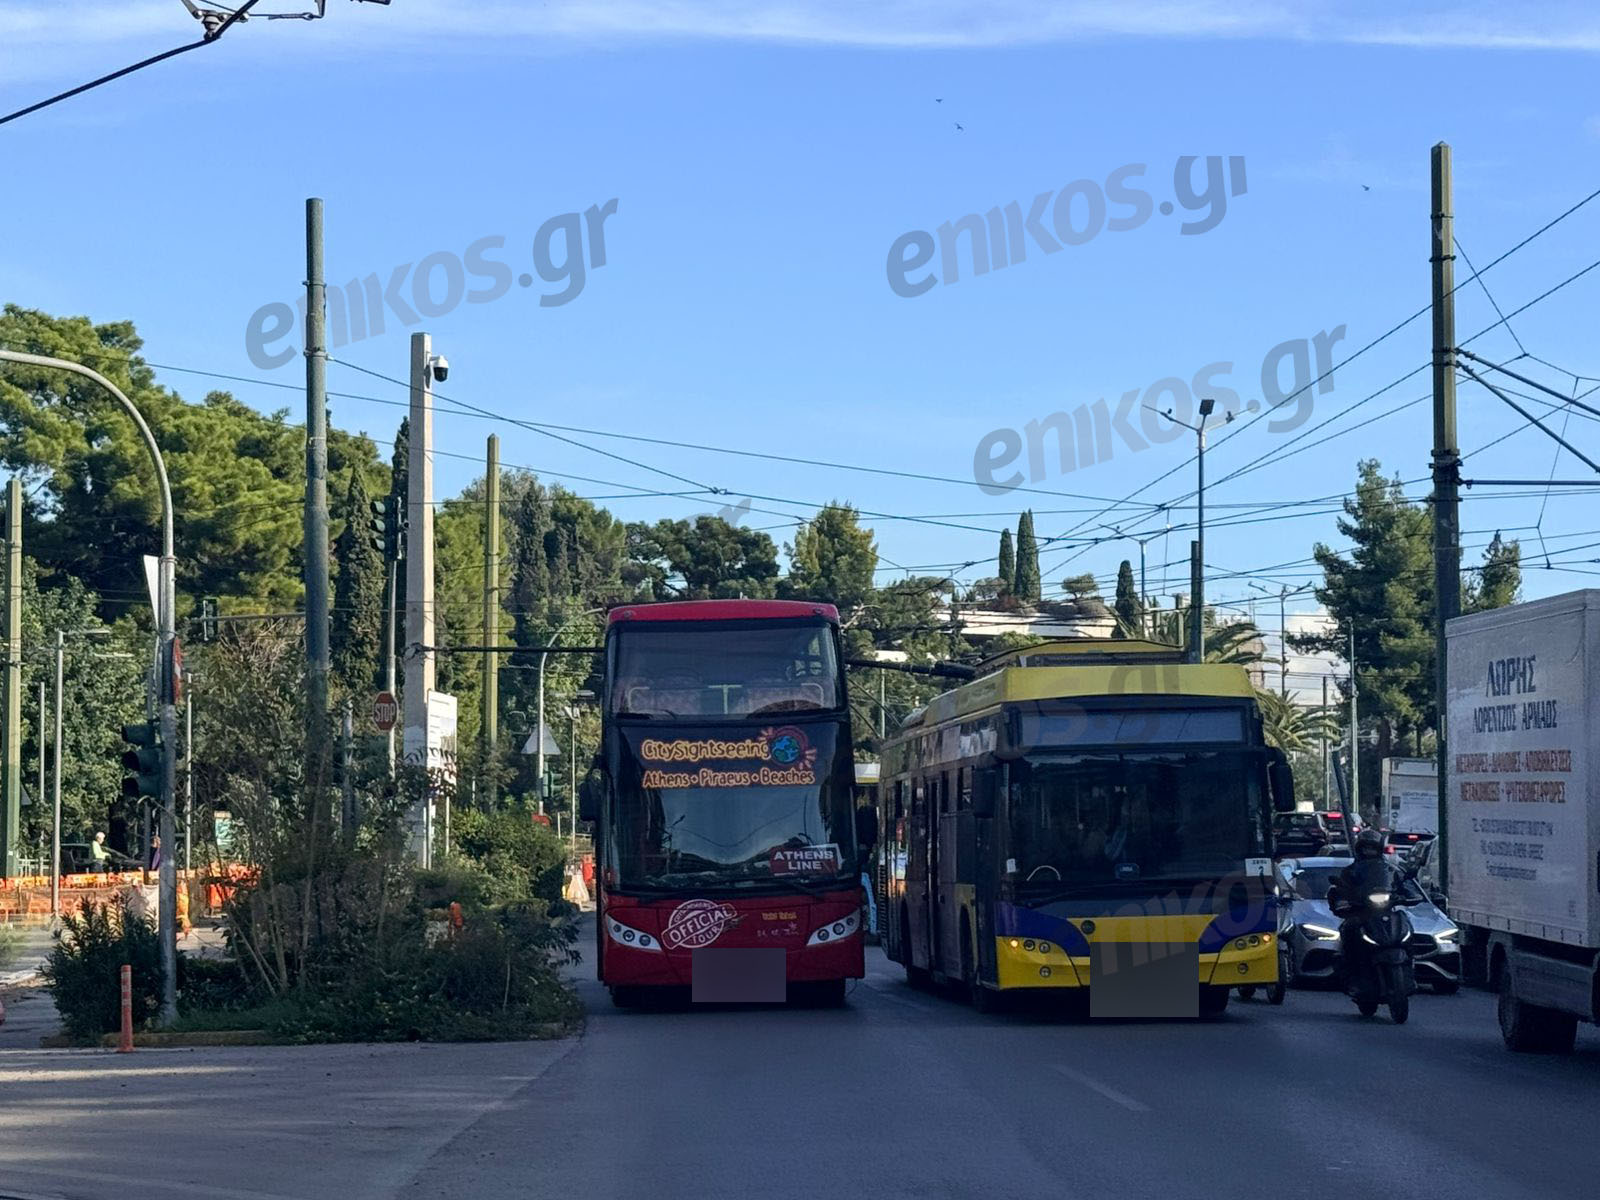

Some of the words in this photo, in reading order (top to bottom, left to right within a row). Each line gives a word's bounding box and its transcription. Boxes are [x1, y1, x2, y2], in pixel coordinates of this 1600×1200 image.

[1486, 654, 1536, 697] ΛΩΡΗΣ
[374, 703, 396, 722] STOP
[642, 769, 690, 789] Athens
[699, 767, 750, 787] Piraeus
[759, 766, 816, 785] Beaches
[773, 850, 834, 861] ATHENS
[787, 860, 823, 871] LINE
[668, 906, 732, 943] OFFICIAL
[691, 925, 722, 944] TOUR
